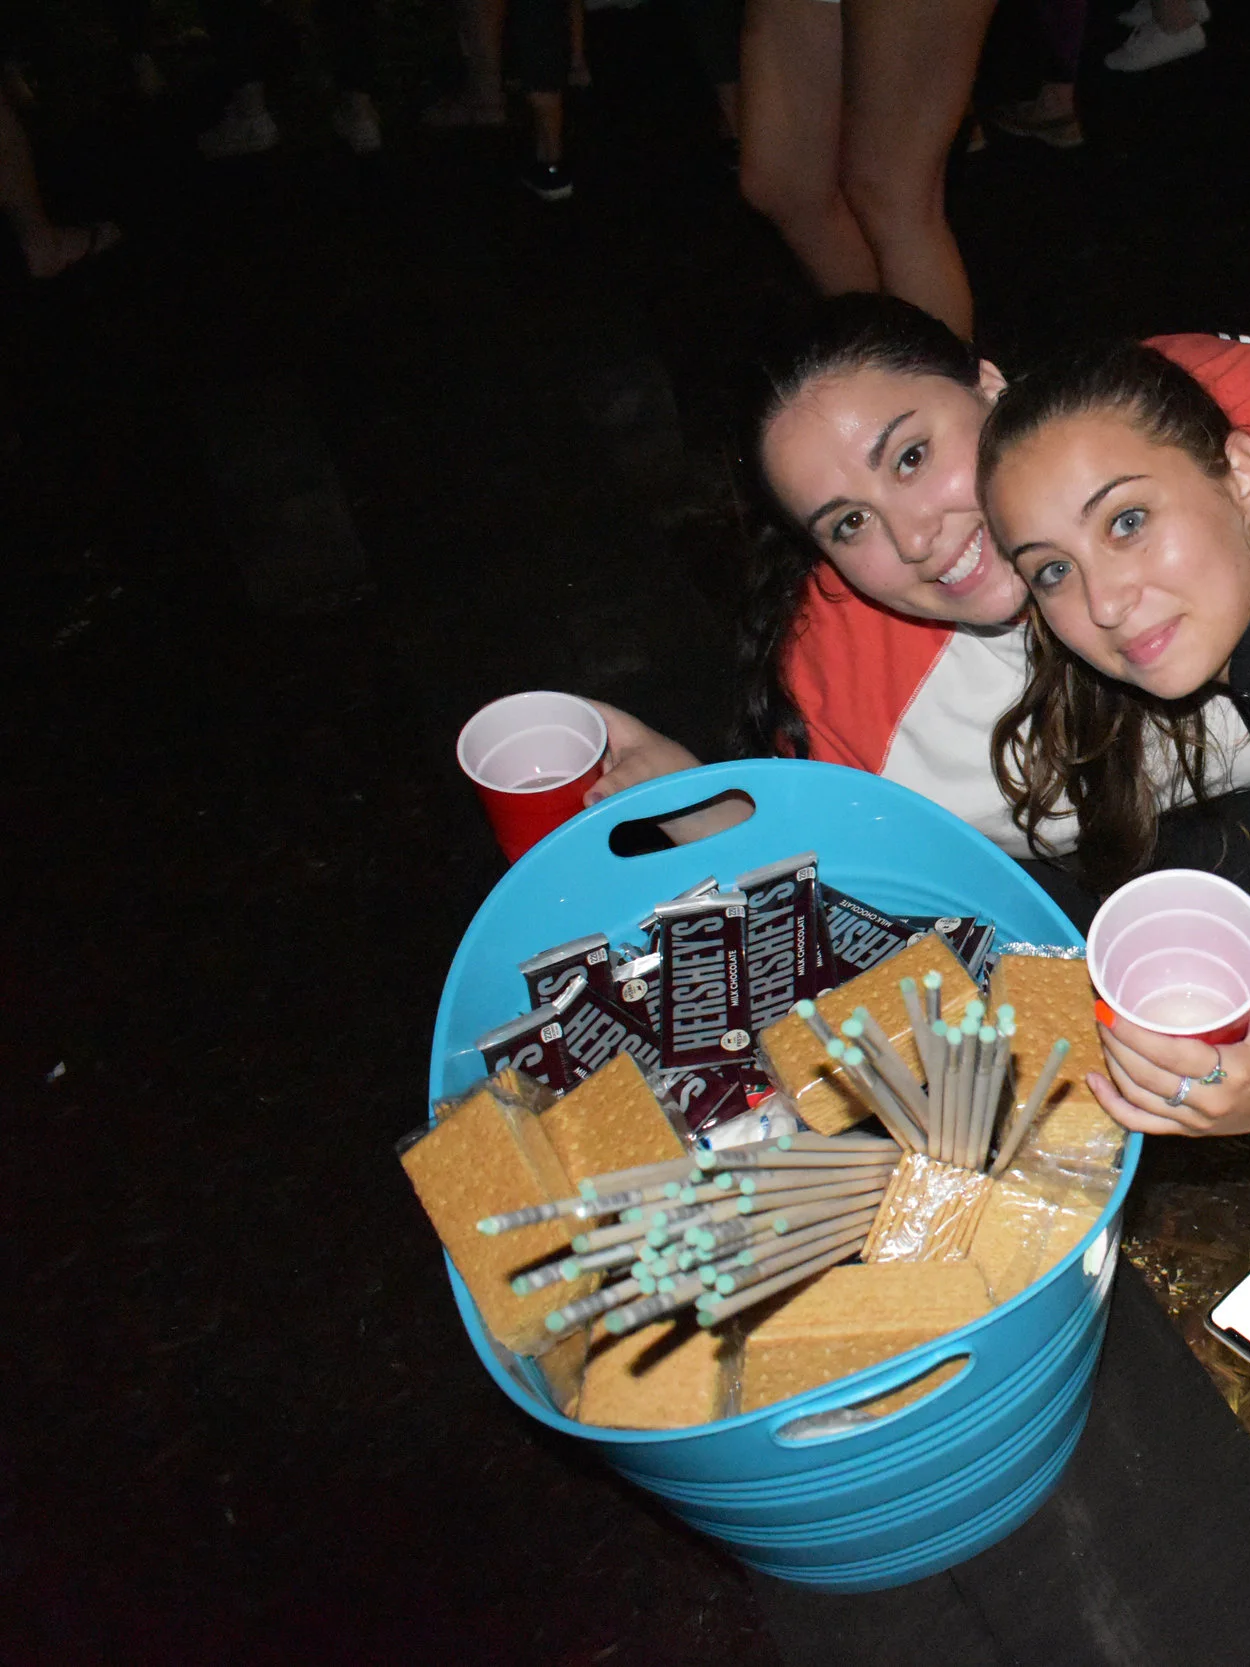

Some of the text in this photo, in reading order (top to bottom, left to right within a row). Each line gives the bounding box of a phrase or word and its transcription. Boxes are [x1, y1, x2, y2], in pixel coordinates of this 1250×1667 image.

[840, 900, 894, 928] MILK CHOCOLATE
[671, 916, 728, 1052] HERSHEY'S
[728, 950, 739, 1007] MILK CHOCOLATE
[748, 881, 796, 1031] HERSHEY'S
[544, 1027, 553, 1041] 220
